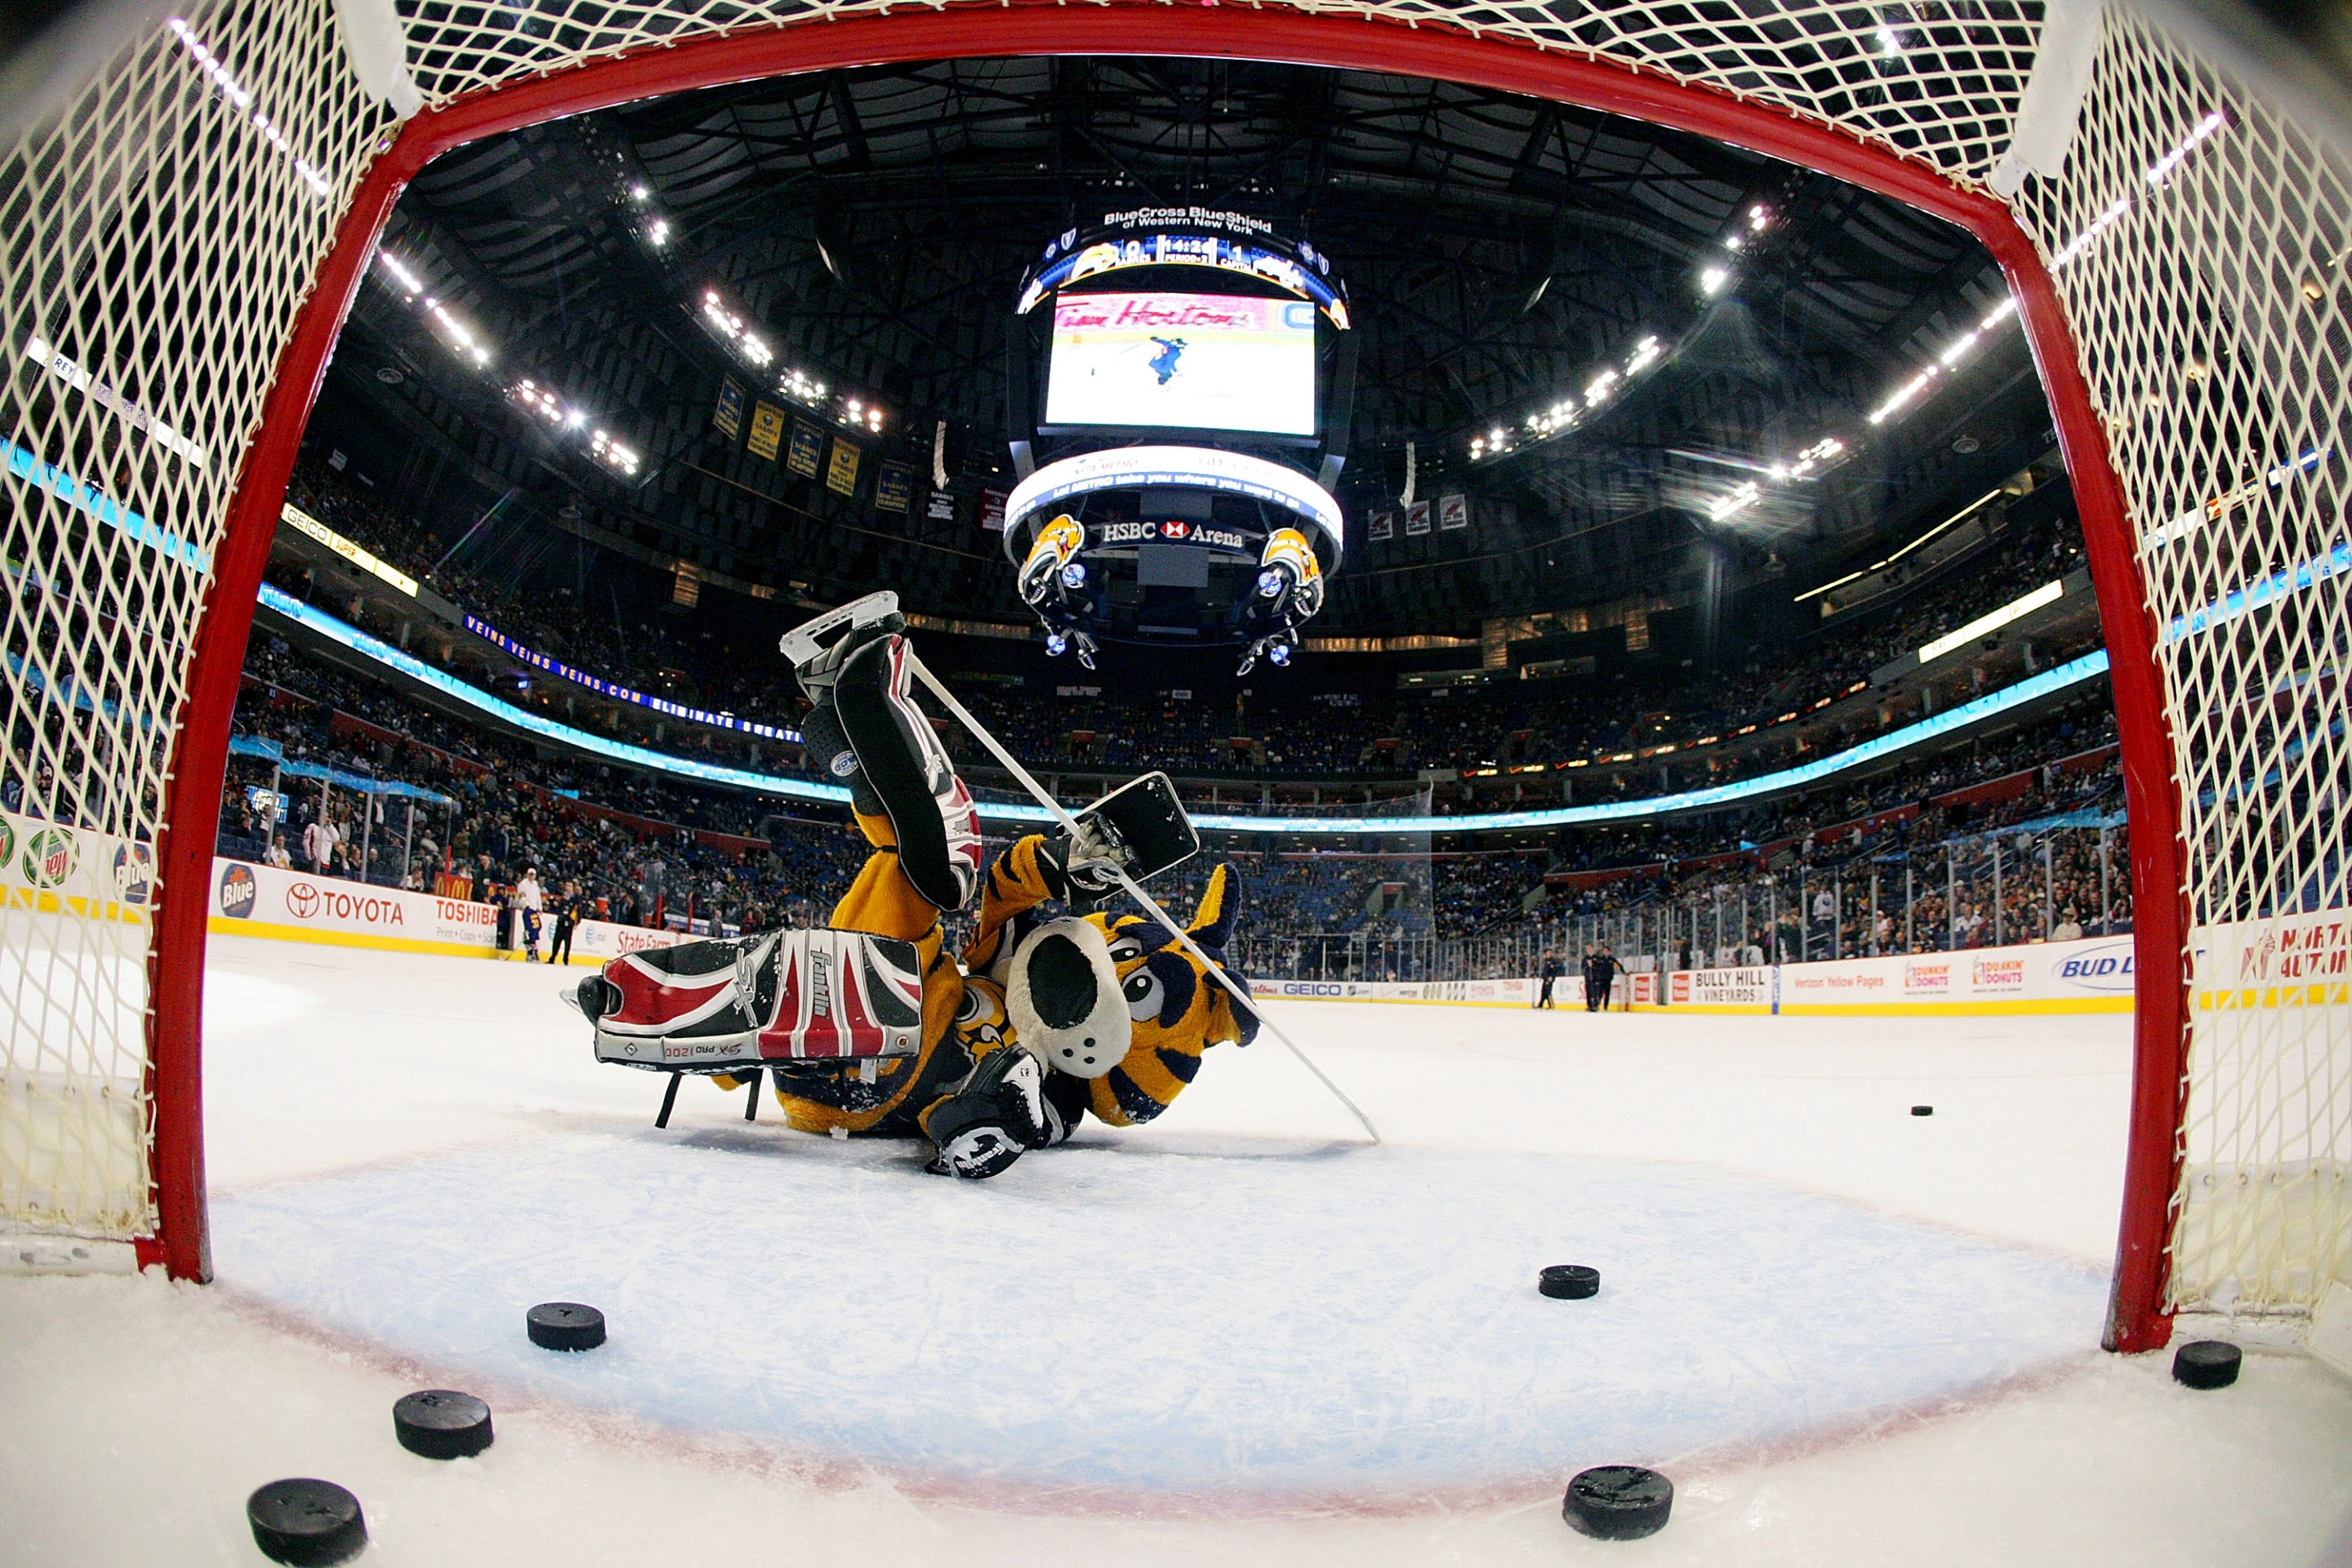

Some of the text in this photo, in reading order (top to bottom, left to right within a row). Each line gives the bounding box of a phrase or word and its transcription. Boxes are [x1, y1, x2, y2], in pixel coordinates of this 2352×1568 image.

[1104, 207, 1272, 234] BlueCross BlueShield
[1122, 216, 1253, 235] of Western New York
[1126, 240, 1141, 255] 0
[1232, 246, 1241, 261] 1
[287, 508, 327, 541] GEICO
[1103, 522, 1156, 542] HSBC
[1189, 524, 1244, 548] Arena
[335, 538, 357, 558] SUPER
[466, 617, 505, 647] VEINS
[510, 641, 550, 670] VEINS
[559, 663, 642, 704] VEINS.COM
[653, 697, 734, 728] ELIMINATE
[222, 880, 253, 908] Blue
[323, 891, 403, 926] TOYOTA
[436, 899, 498, 926] TOSHIBA
[437, 926, 454, 939] Print
[460, 929, 476, 943] Copy
[617, 931, 672, 954] State Farm
[1985, 972, 2023, 983] DONUTS
[2061, 958, 2117, 978] BUD
[1696, 972, 1732, 987] BULLY
[1736, 969, 1765, 986] HILL
[1794, 974, 1885, 990] Verizon Yellow Pages
[1916, 976, 1949, 987] DONUTS
[1284, 983, 1342, 996] GEICO
[1704, 988, 1755, 1003] VINEYARDS
[665, 1047, 693, 1058] 1200
[696, 1045, 715, 1054] PRO
